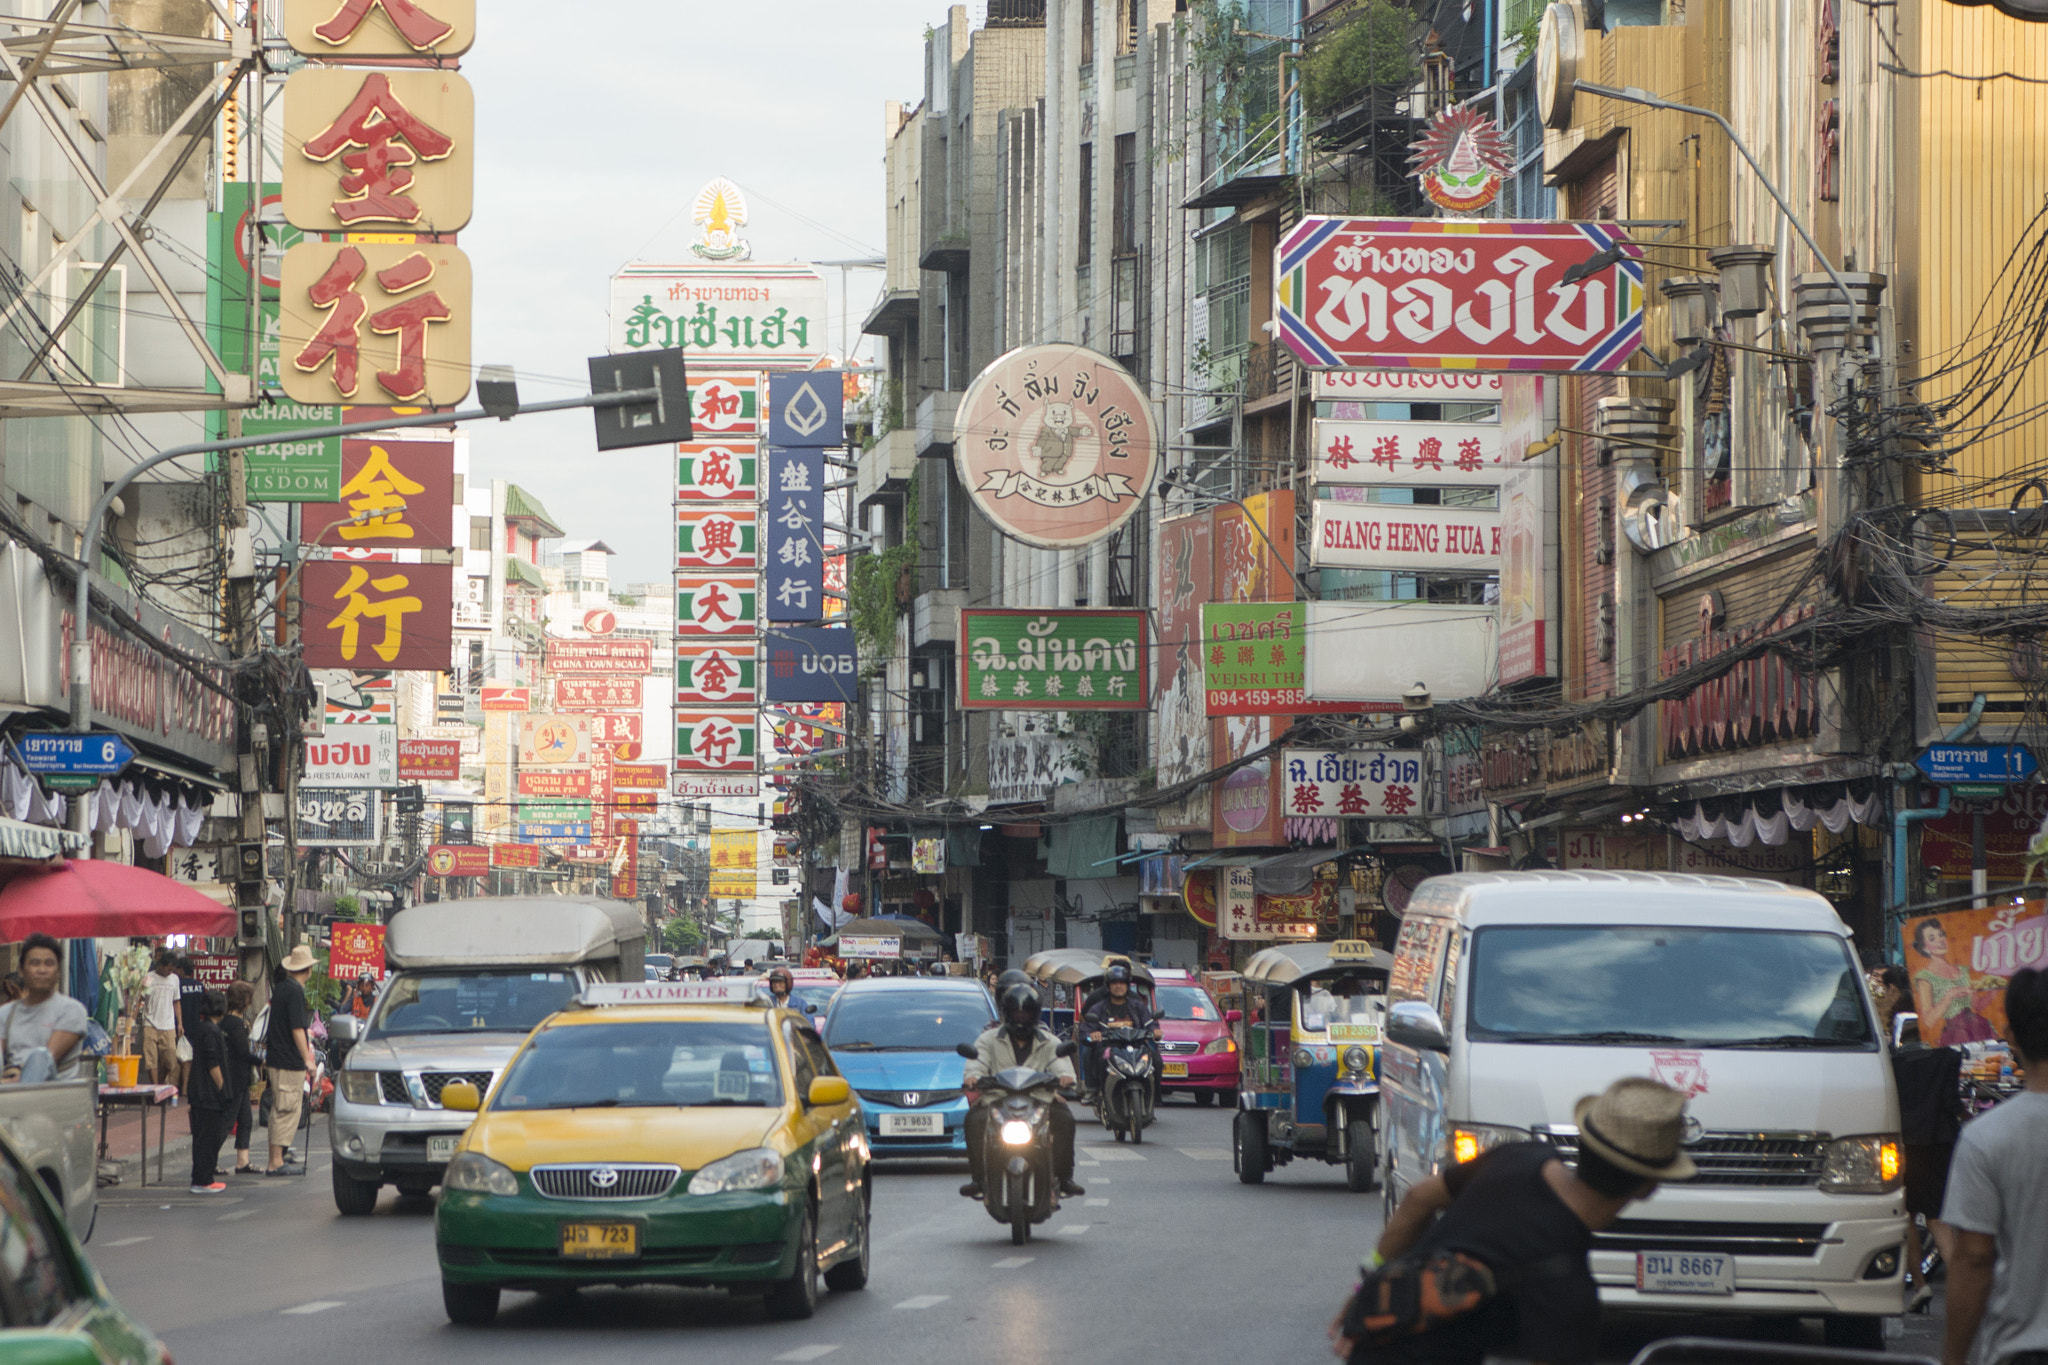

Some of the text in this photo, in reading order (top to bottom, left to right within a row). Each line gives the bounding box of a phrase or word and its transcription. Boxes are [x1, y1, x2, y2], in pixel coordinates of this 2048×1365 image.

[1334, 236, 1475, 274] ห้างทอง
[668, 283, 770, 301] ห้างขายทอง
[240, 405, 333, 420] XCHANGE
[244, 441, 325, 460] -Expert
[1324, 434, 1500, 473] 林祥興藥
[246, 476, 329, 489] ISDOM
[776, 459, 812, 609] 盤谷銀行
[1324, 519, 1382, 550] SIANG
[1387, 522, 1439, 554] HENG
[1445, 525, 1485, 555] HUA
[1212, 611, 1293, 642] เวชศรี
[972, 616, 1136, 672] ฉ.มั่นคง
[553, 660, 646, 669] CHINA TOWN SCALA
[802, 654, 854, 674] UOB
[1210, 672, 1267, 686] VEJSRI
[25, 738, 116, 762] เยาวราช 6
[1930, 750, 1988, 763] เยาวราช
[314, 772, 371, 780] RESTAURANT
[1291, 783, 1417, 816] 蔡益發
[1337, 943, 1365, 954] TAXI
[1351, 1026, 1377, 1036] 2356
[600, 1226, 629, 1243] 723
[1679, 1257, 1724, 1276] 8667
